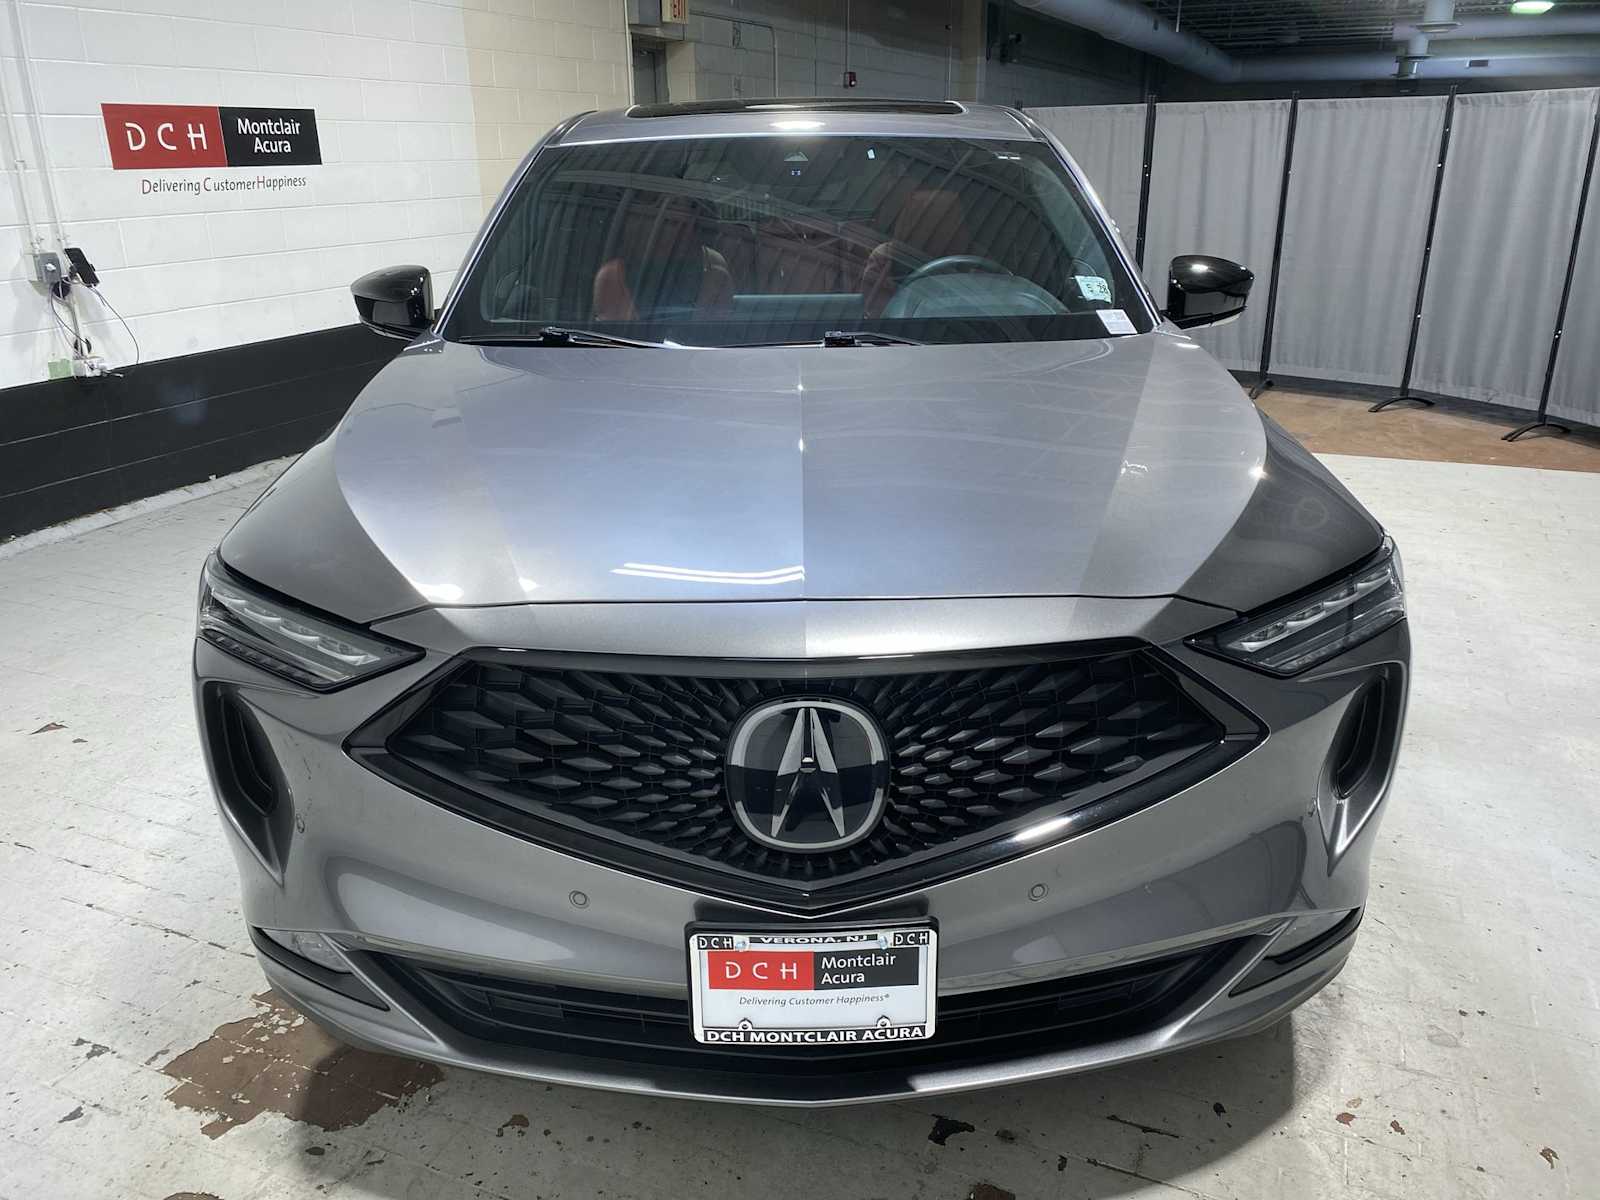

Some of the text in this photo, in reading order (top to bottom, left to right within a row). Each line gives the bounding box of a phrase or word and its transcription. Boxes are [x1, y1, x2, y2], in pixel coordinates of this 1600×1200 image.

[237, 117, 301, 136] Montclair
[253, 137, 292, 154] Acura
[141, 178, 201, 196] Delivering
[846, 934, 868, 942] NJ
[821, 953, 896, 970] Montclair
[821, 970, 865, 985] Acura
[739, 995, 787, 1007] Delivering
[788, 995, 834, 1006] Customer
[706, 1026, 924, 1043] DCH MONTCLAIR ACURA
